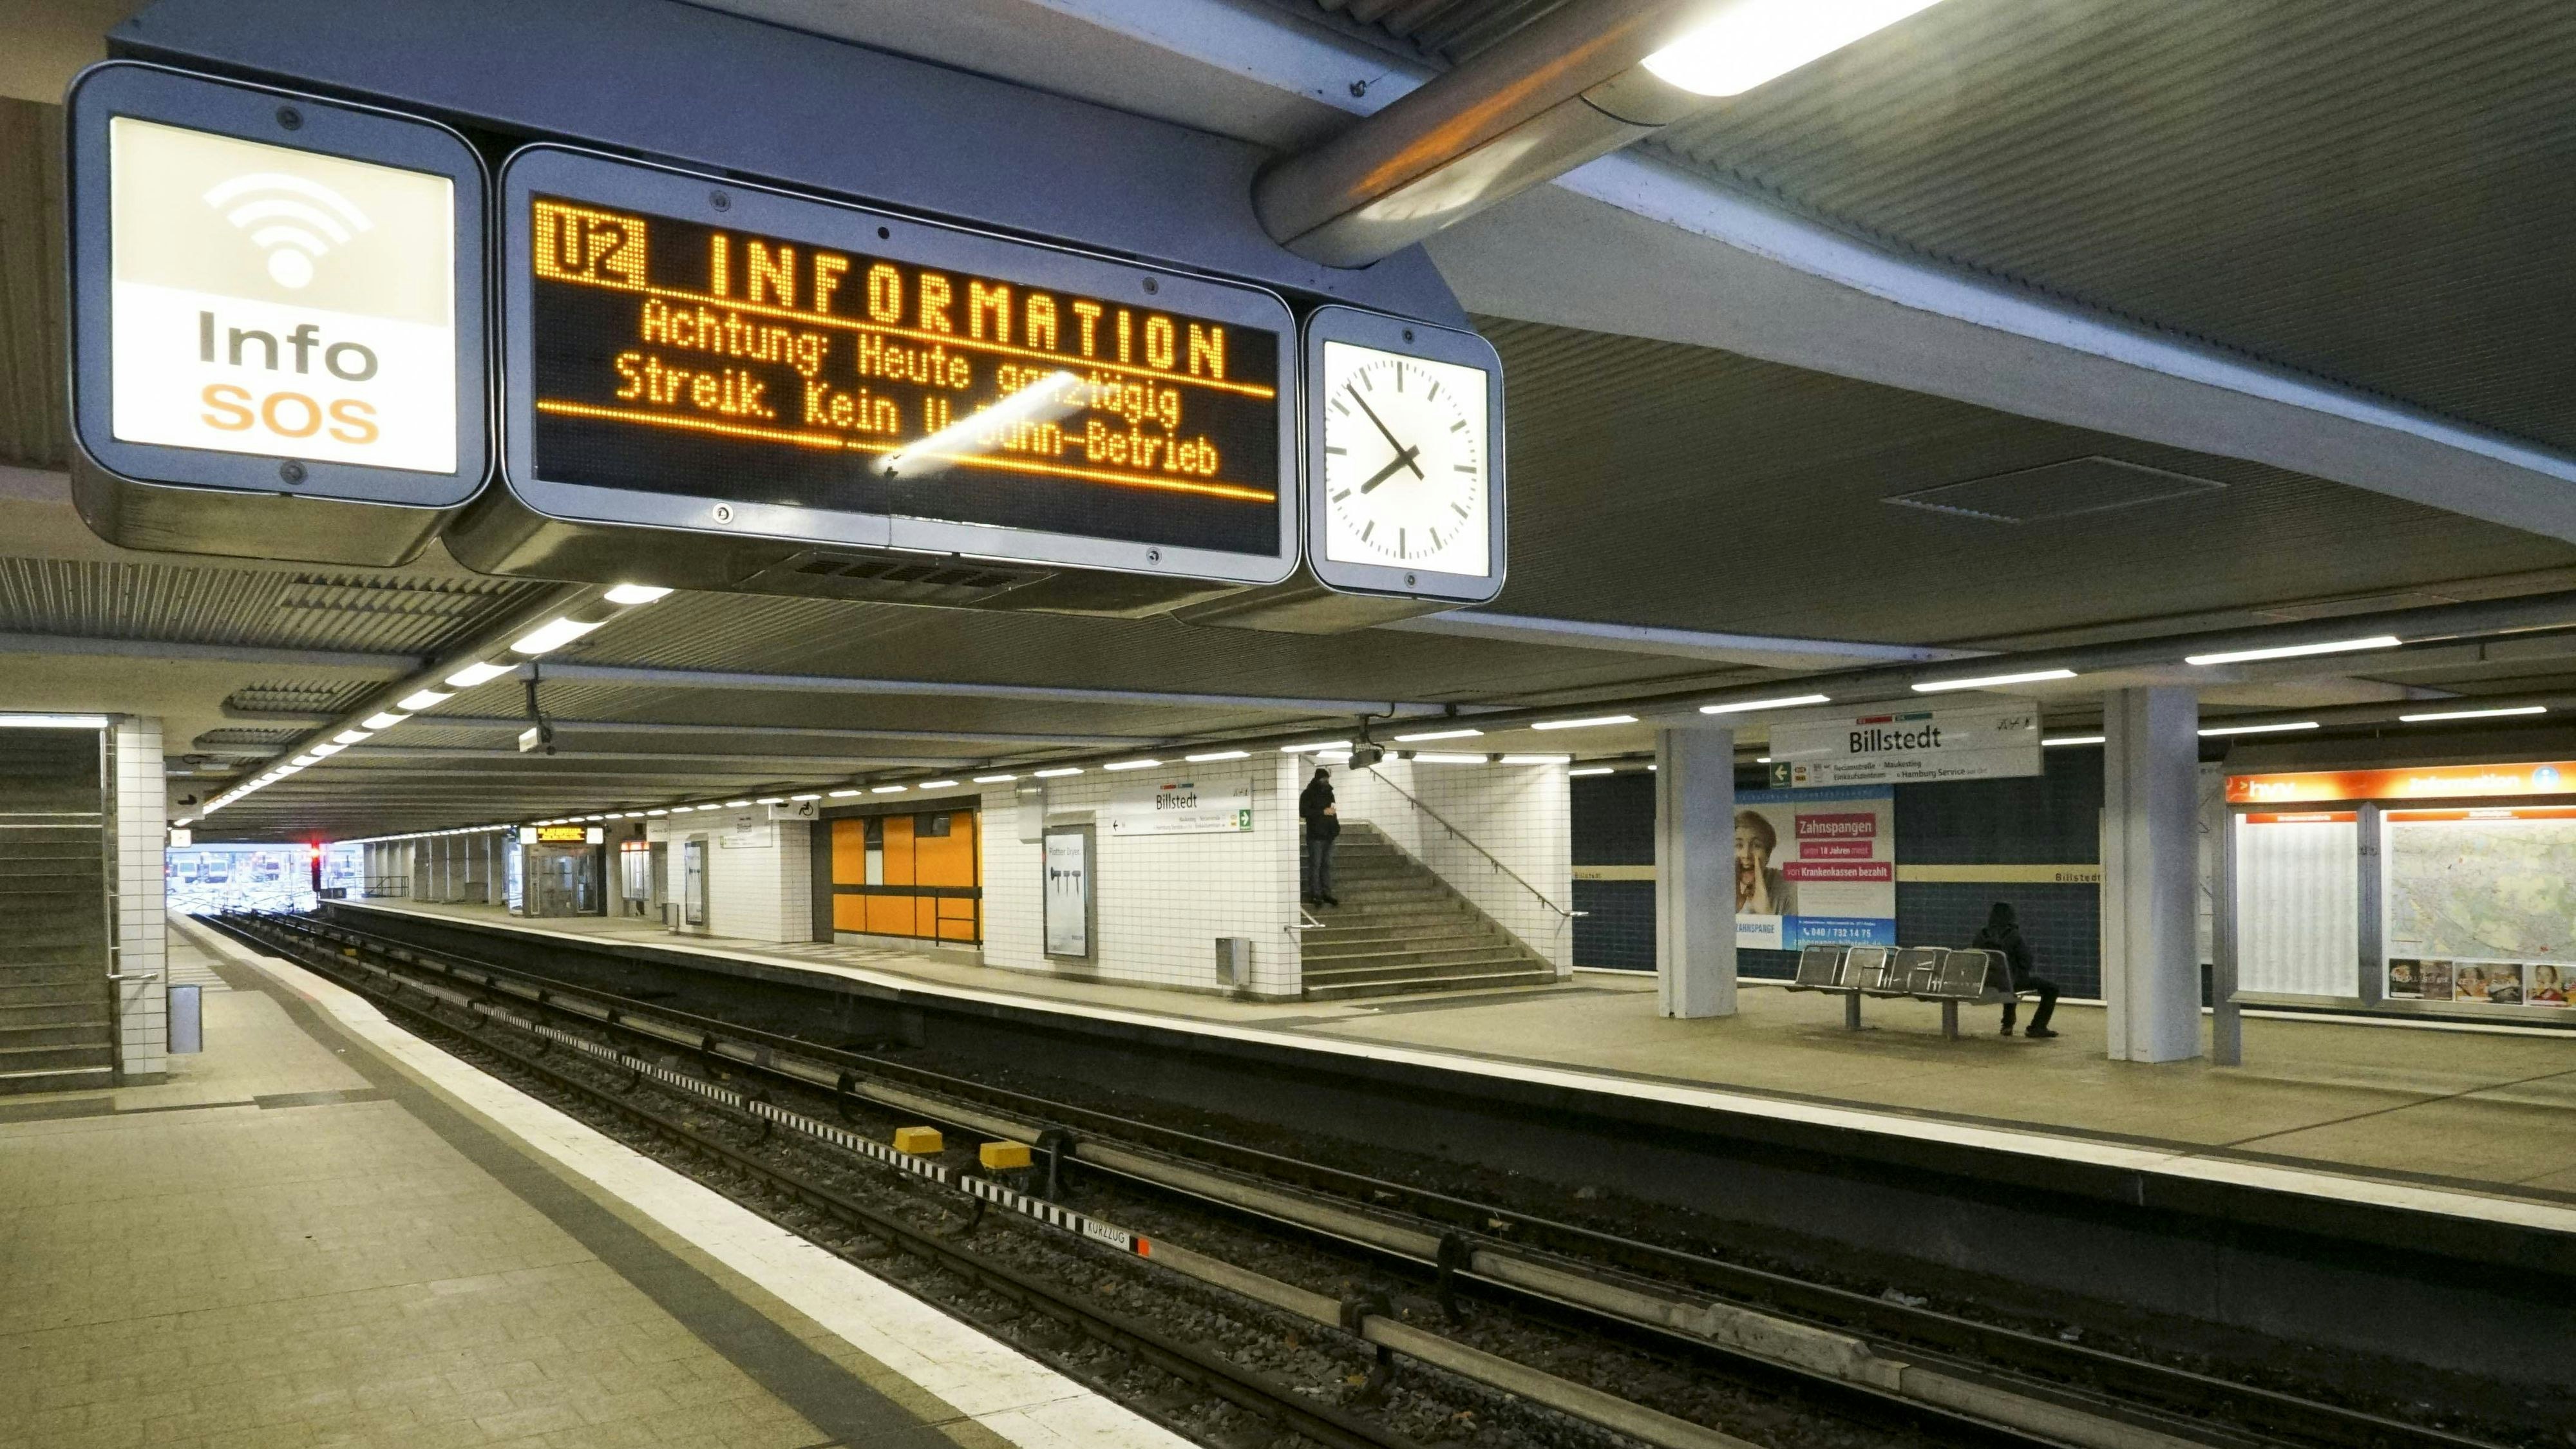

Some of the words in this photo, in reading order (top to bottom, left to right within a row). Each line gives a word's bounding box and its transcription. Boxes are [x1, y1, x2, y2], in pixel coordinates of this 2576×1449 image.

[551, 211, 632, 282] U2
[712, 234, 1222, 378] INFORMATION
[199, 311, 379, 381] Info
[644, 298, 828, 377] Achtung:
[859, 333, 969, 389] Heute
[616, 353, 773, 417] Streik.
[806, 381, 896, 433] Kein
[200, 384, 379, 444] SOS
[1850, 725, 1941, 753] Billstedt
[1902, 770, 1937, 779] Hamburg
[1938, 768, 1965, 776] Service
[2409, 773, 2521, 791] Information
[2249, 780, 2295, 797] hvv
[1156, 792, 1197, 810] Billstedt
[1800, 820, 1872, 836] Zahnspangen
[1829, 846, 1851, 855] Jahren
[1801, 867, 1857, 876] Krankenkassen
[1859, 866, 1887, 876] bezahlt
[2056, 873, 2101, 882] Billstedt
[1833, 929, 1846, 937] 732
[1850, 929, 1859, 937] 14
[1088, 1221, 1125, 1244] KURZZUG
